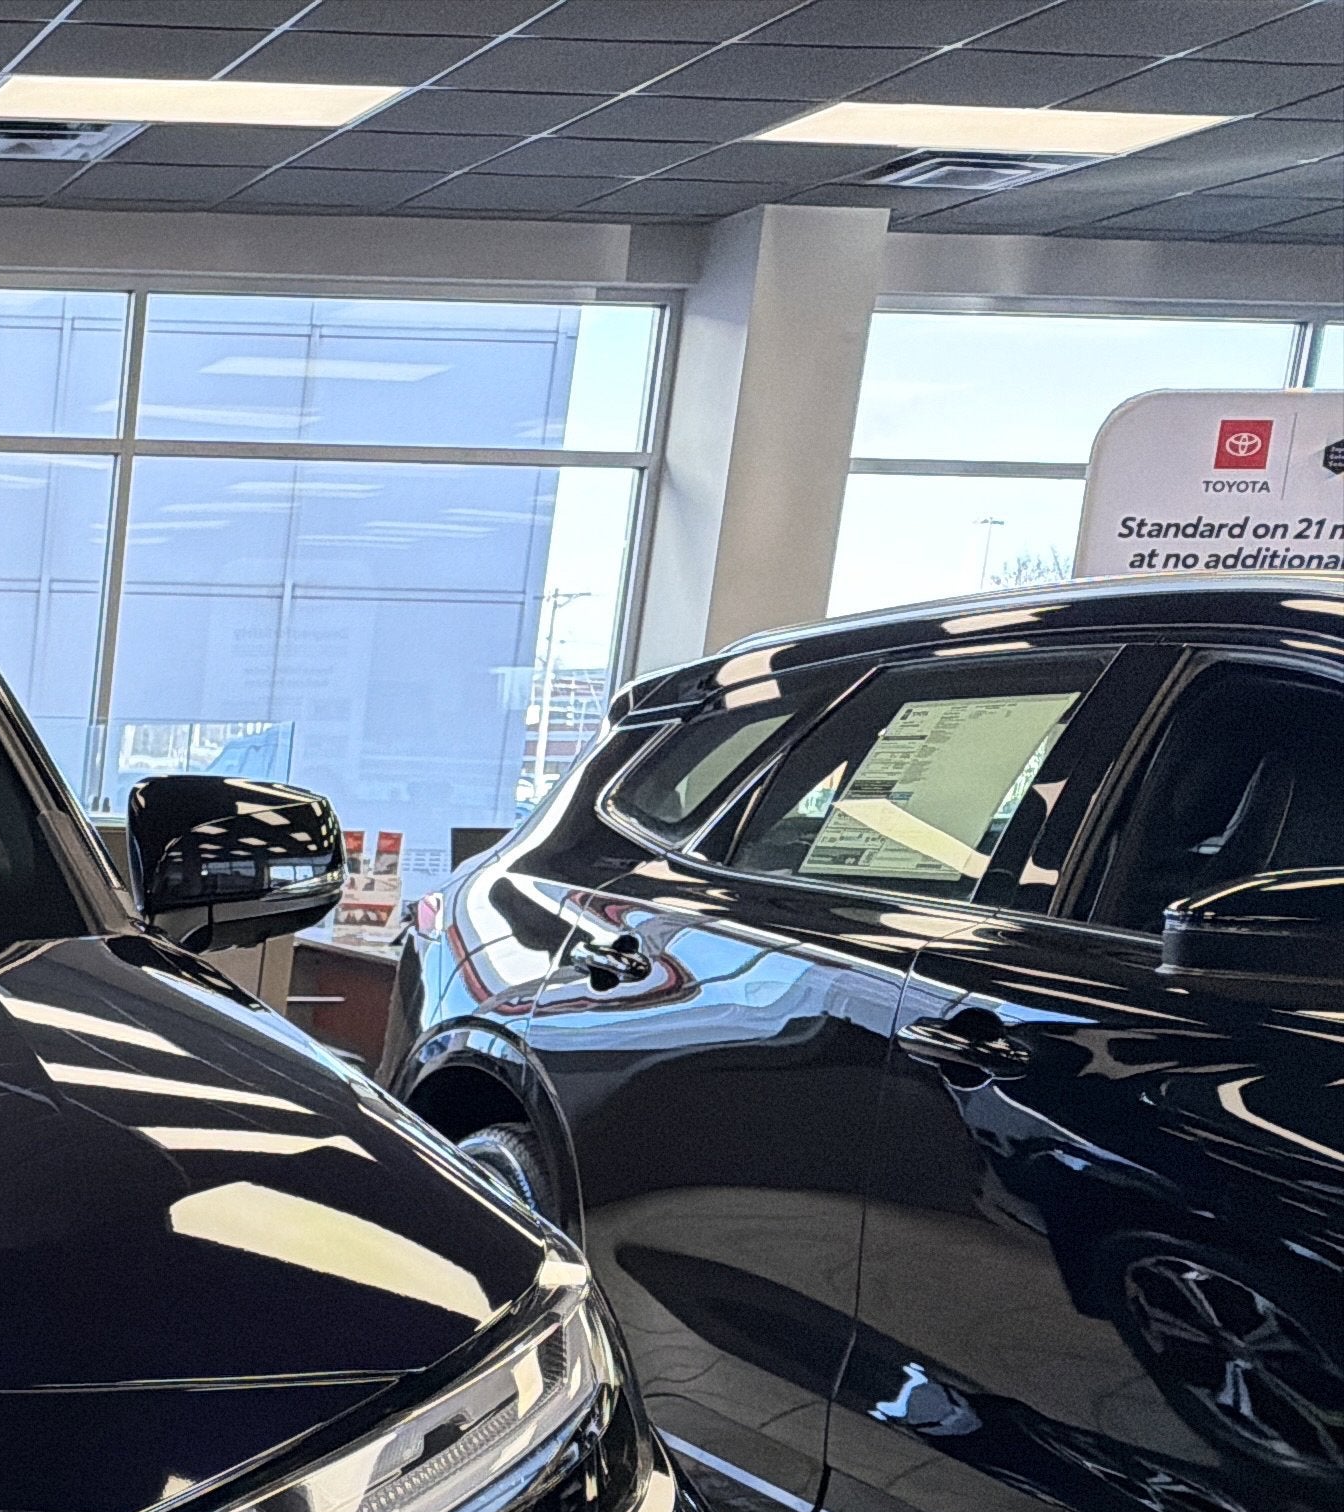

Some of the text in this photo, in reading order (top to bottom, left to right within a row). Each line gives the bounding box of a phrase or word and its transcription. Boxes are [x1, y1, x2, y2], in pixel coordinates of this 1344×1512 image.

[1202, 480, 1270, 493] TOYOTA
[1117, 516, 1250, 539] Standard
[1252, 523, 1288, 539] on
[1293, 518, 1326, 539] 21
[1129, 549, 1157, 569] at
[1162, 553, 1199, 569] no
